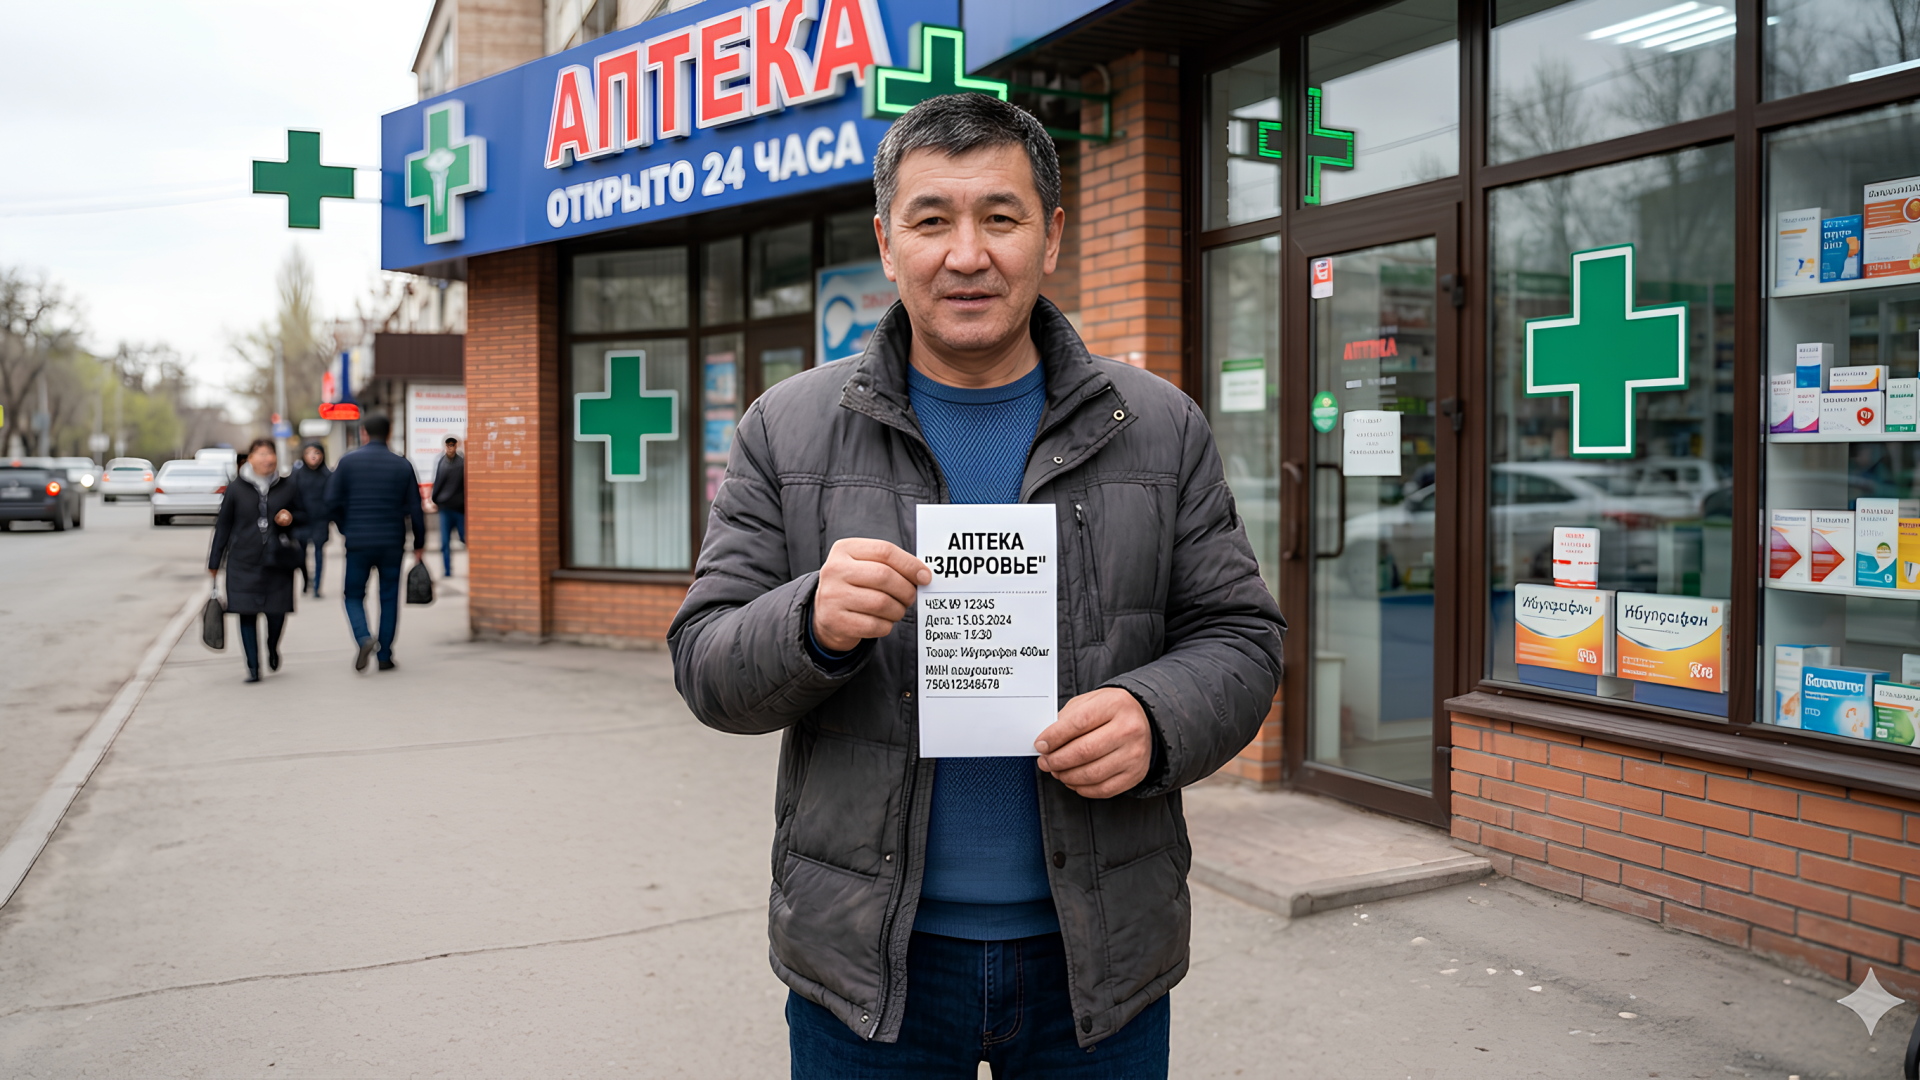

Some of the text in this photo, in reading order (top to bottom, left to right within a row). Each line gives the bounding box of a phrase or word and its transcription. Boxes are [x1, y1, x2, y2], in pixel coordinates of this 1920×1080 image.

[545, 0, 888, 169] АПТЕКА
[547, 121, 865, 228] ОТКРЫТО 24 ЧАСА
[925, 555, 1046, 578] "ЗДОРОВЬЕ"
[948, 532, 1024, 550] АПТЕКА
